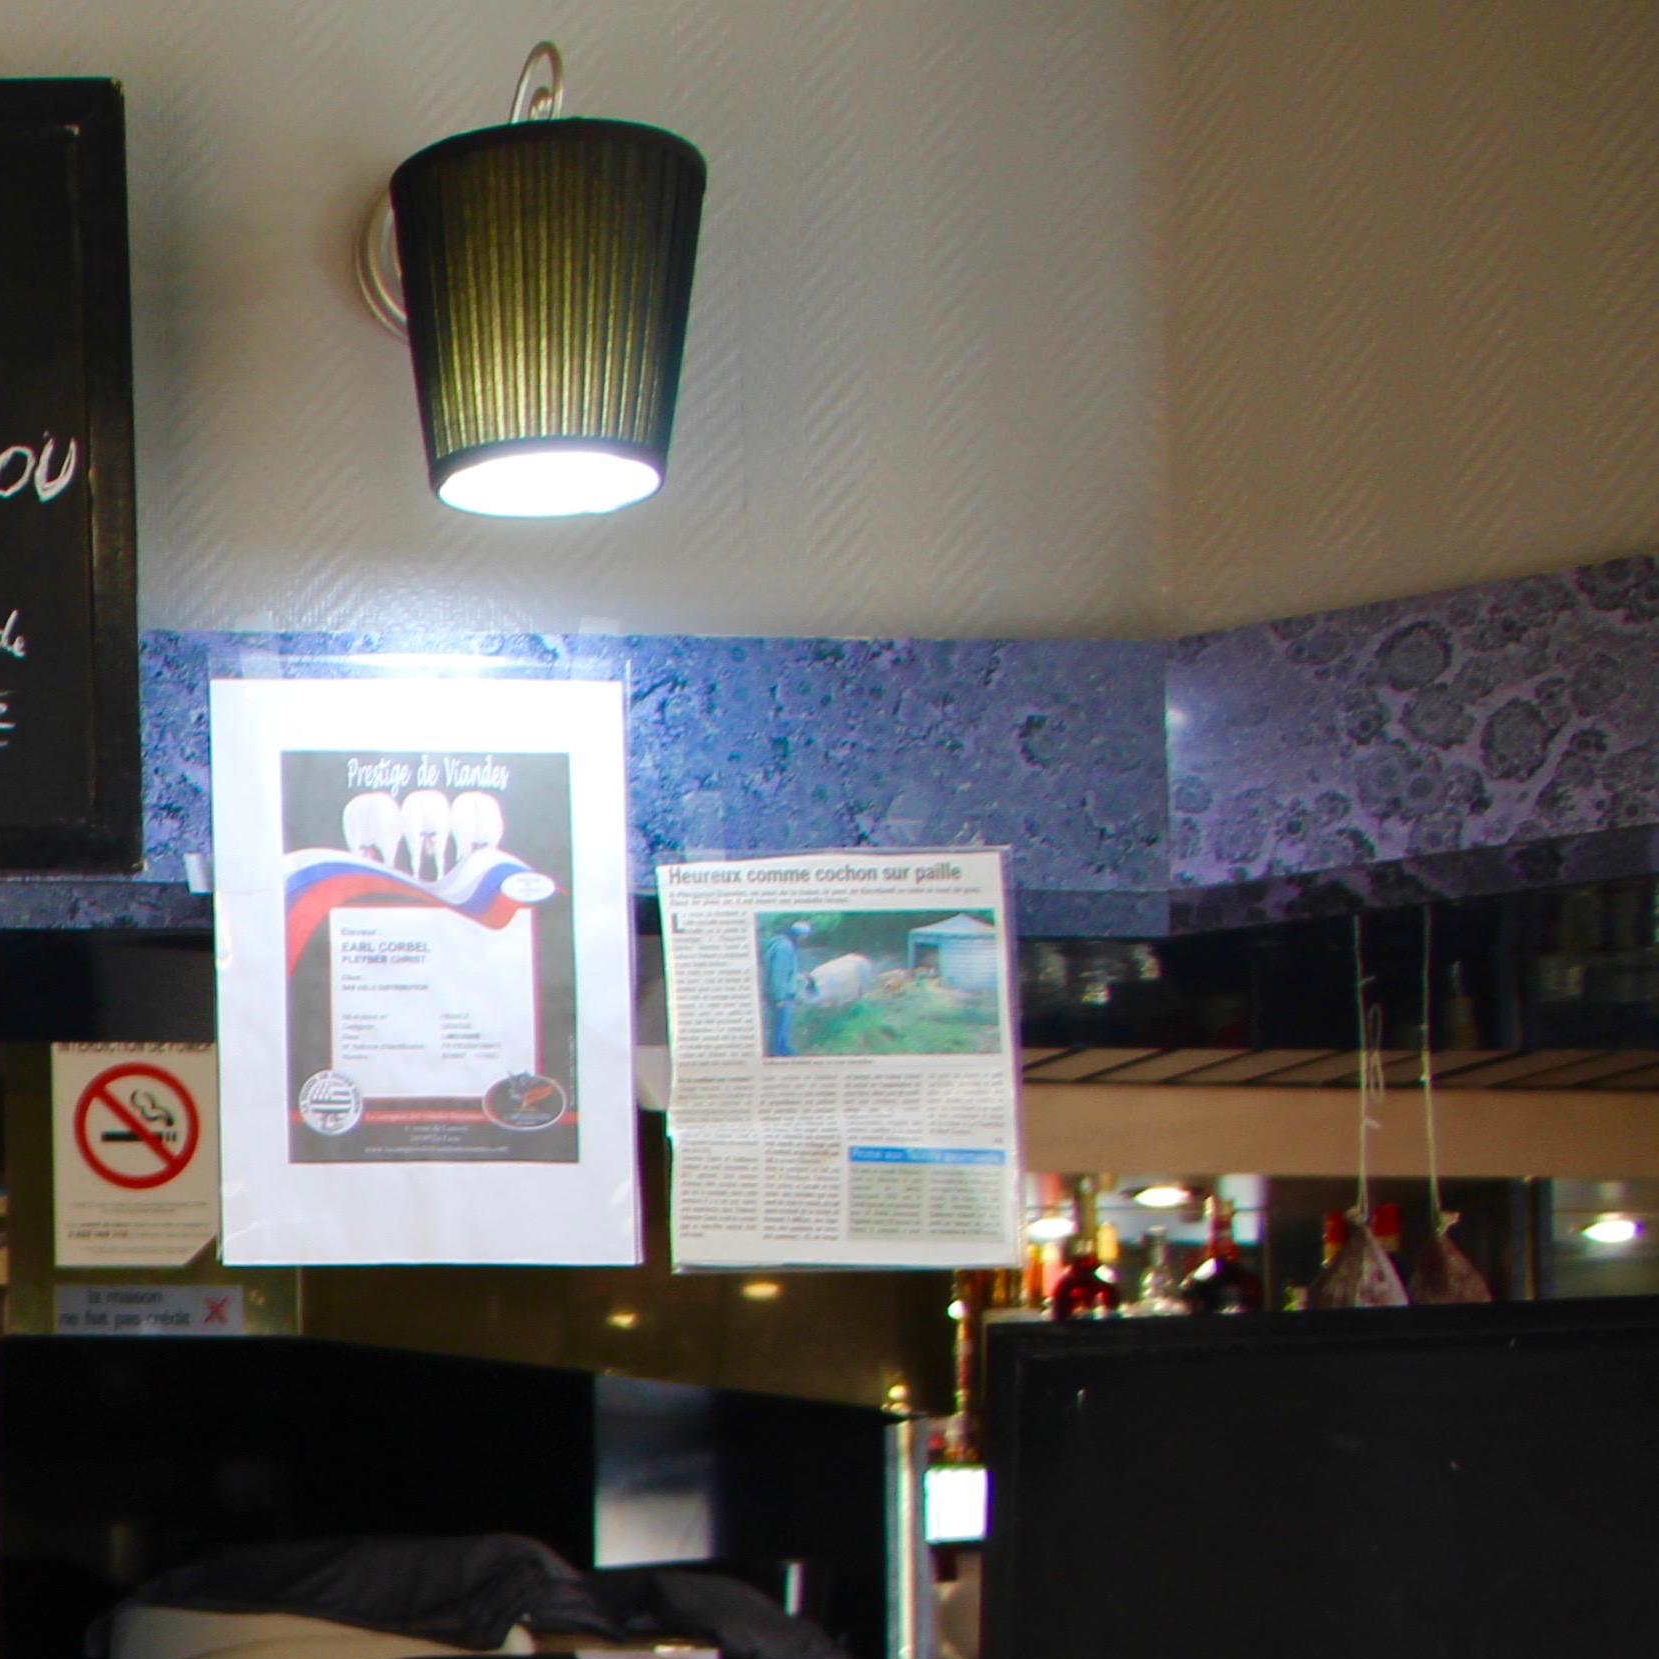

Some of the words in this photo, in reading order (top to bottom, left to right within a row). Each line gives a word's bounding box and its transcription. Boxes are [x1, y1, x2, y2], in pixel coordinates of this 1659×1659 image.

[346, 757, 411, 796] Prestige
[417, 755, 439, 787] de
[444, 755, 509, 790] Viandes
[669, 866, 741, 886] Heureux
[747, 867, 810, 883] comme
[815, 863, 877, 882] cochon
[882, 867, 910, 881] sur
[915, 862, 962, 885] paille
[341, 942, 374, 953] EARL
[378, 941, 430, 953] CORBEL
